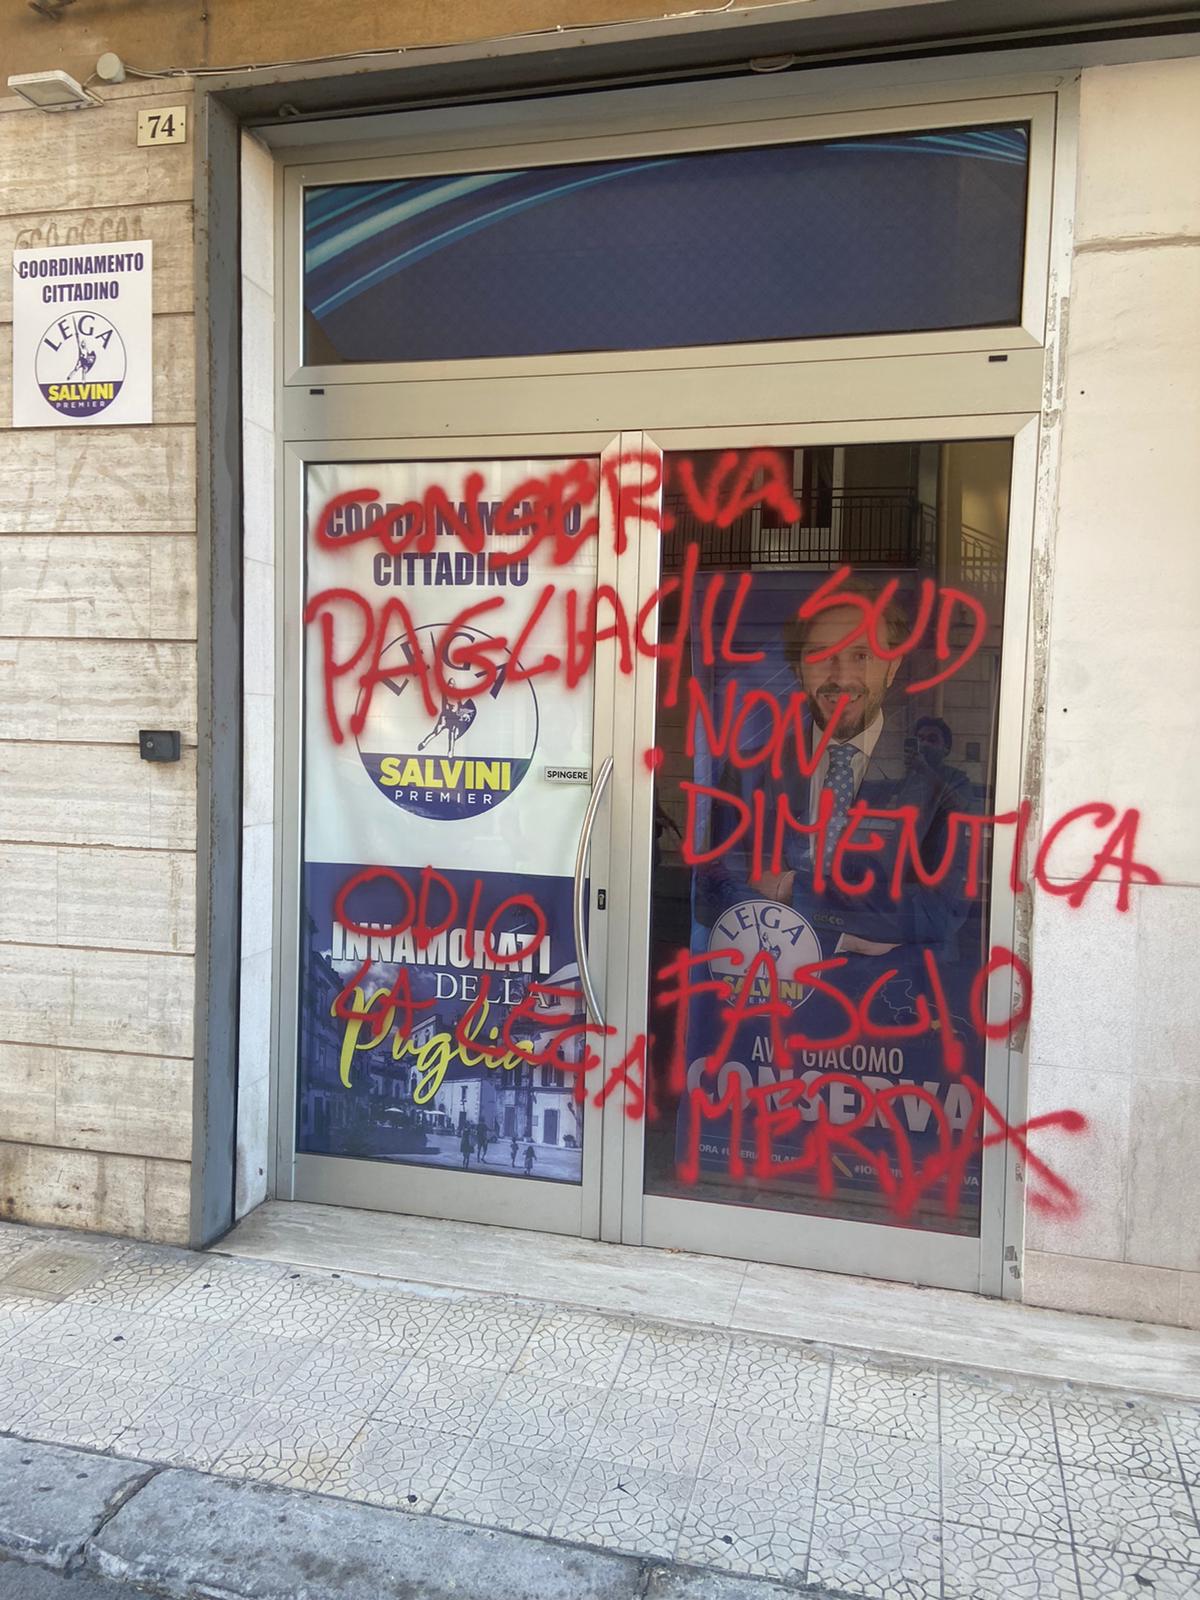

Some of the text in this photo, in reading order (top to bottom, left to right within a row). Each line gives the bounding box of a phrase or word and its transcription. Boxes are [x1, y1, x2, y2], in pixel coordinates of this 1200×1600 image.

[148, 114, 175, 138] 74
[19, 252, 144, 279] COORDINAMENTO
[42, 281, 119, 303] CITTADINO
[44, 315, 114, 352] LEGA
[48, 383, 114, 401] SALVINI
[56, 401, 105, 409] PREMIER
[326, 502, 581, 537] COORDNAMENO
[373, 551, 529, 586] CITTADINO
[797, 565, 988, 695] SUD
[686, 676, 852, 781] NON
[379, 757, 511, 790] SALVINI
[547, 769, 589, 780] SPINGERE
[395, 790, 493, 804] PREMIER
[679, 780, 1163, 913] DIMENTICA
[334, 864, 547, 960] ODIO
[718, 905, 805, 946] LEGA
[332, 921, 551, 974] INNAMORATI
[723, 975, 804, 1000] SALVNI
[657, 944, 1034, 1092] FASCIO
[330, 984, 536, 1105] Puglia
[802, 1042, 904, 1075] GIACOMO
